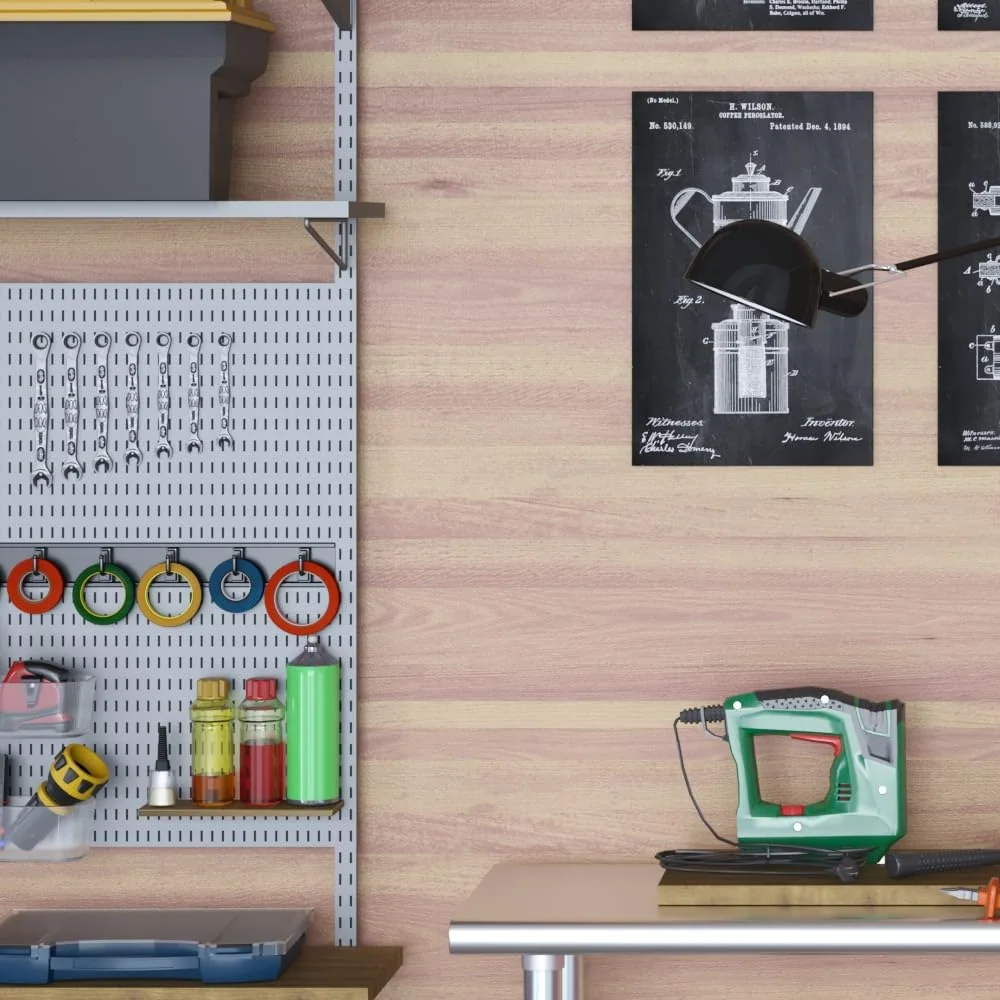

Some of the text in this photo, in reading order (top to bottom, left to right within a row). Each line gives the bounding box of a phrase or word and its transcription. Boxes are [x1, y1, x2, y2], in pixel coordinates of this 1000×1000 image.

[649, 121, 661, 129] No.
[769, 122, 803, 130] Patented
[824, 123, 831, 131] 4,
